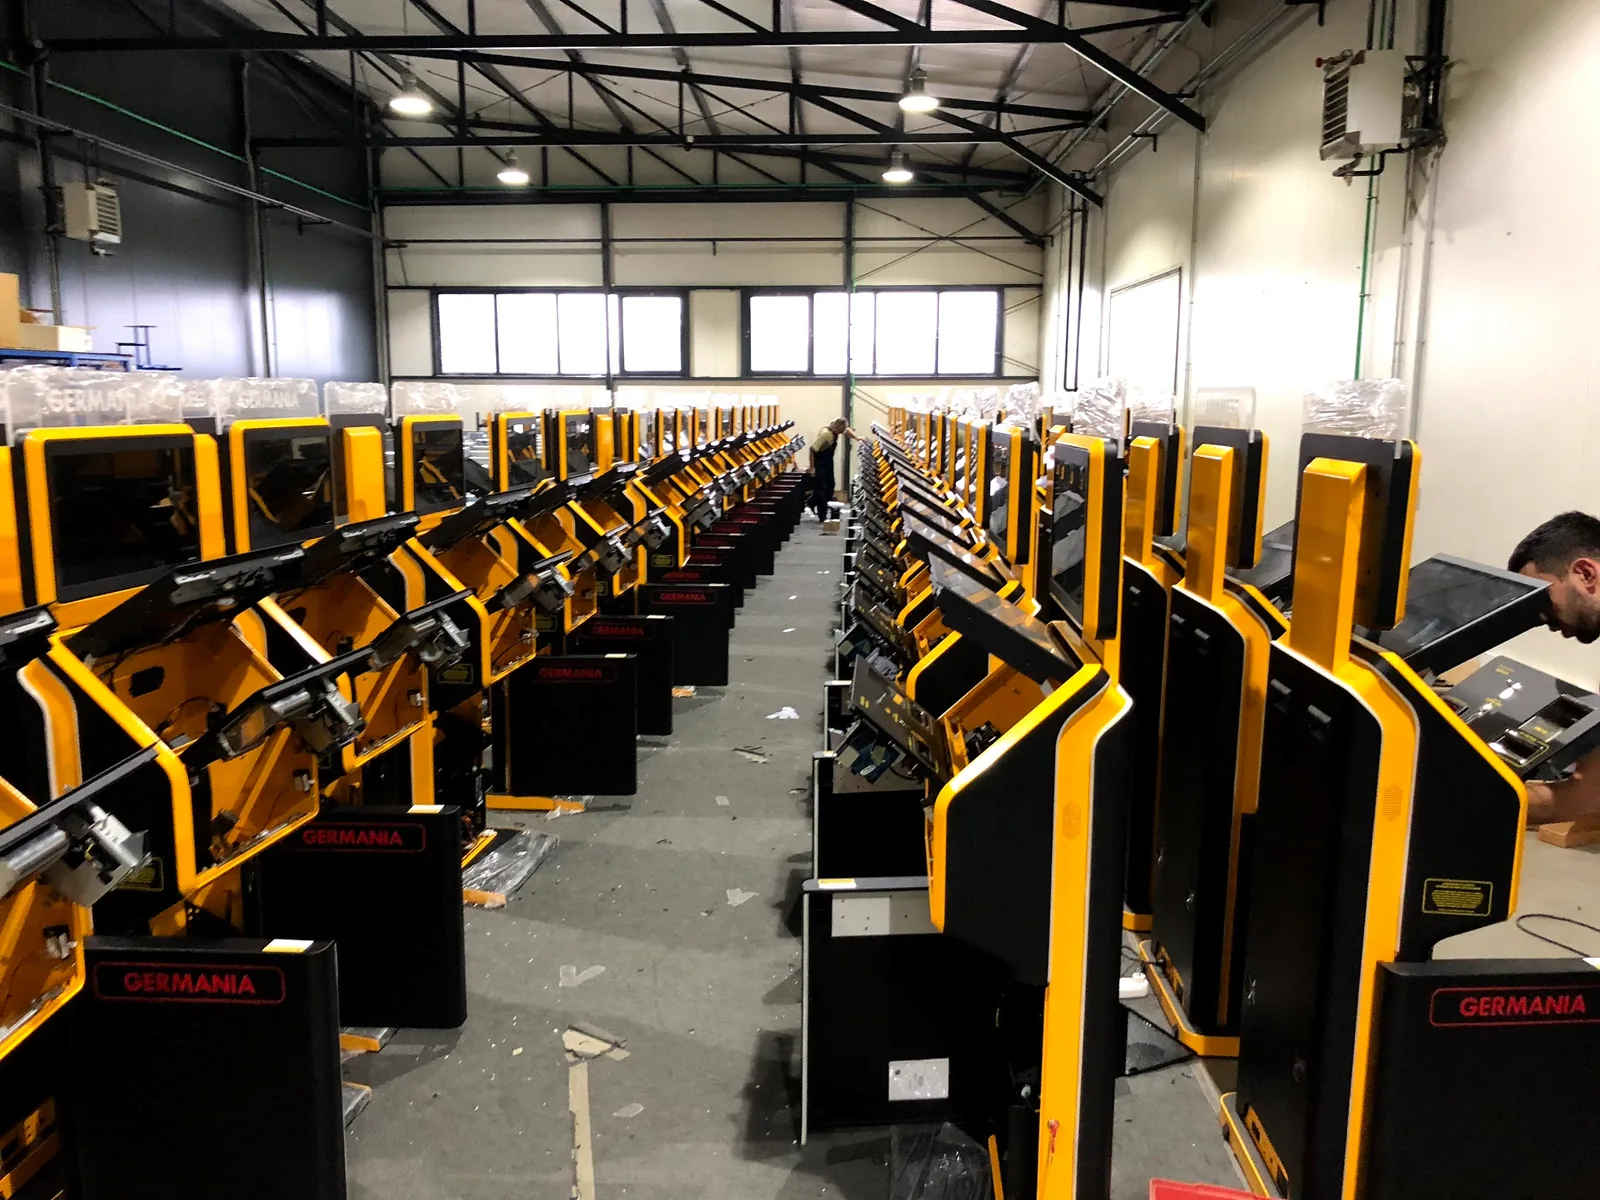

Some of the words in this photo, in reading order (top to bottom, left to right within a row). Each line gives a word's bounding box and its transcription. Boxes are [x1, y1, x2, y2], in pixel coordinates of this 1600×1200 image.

[539, 668, 603, 678] GERMANIA
[303, 829, 403, 846] GERMANIA
[123, 972, 256, 994] GERMANIA
[1460, 994, 1586, 1017] GERMANIA
